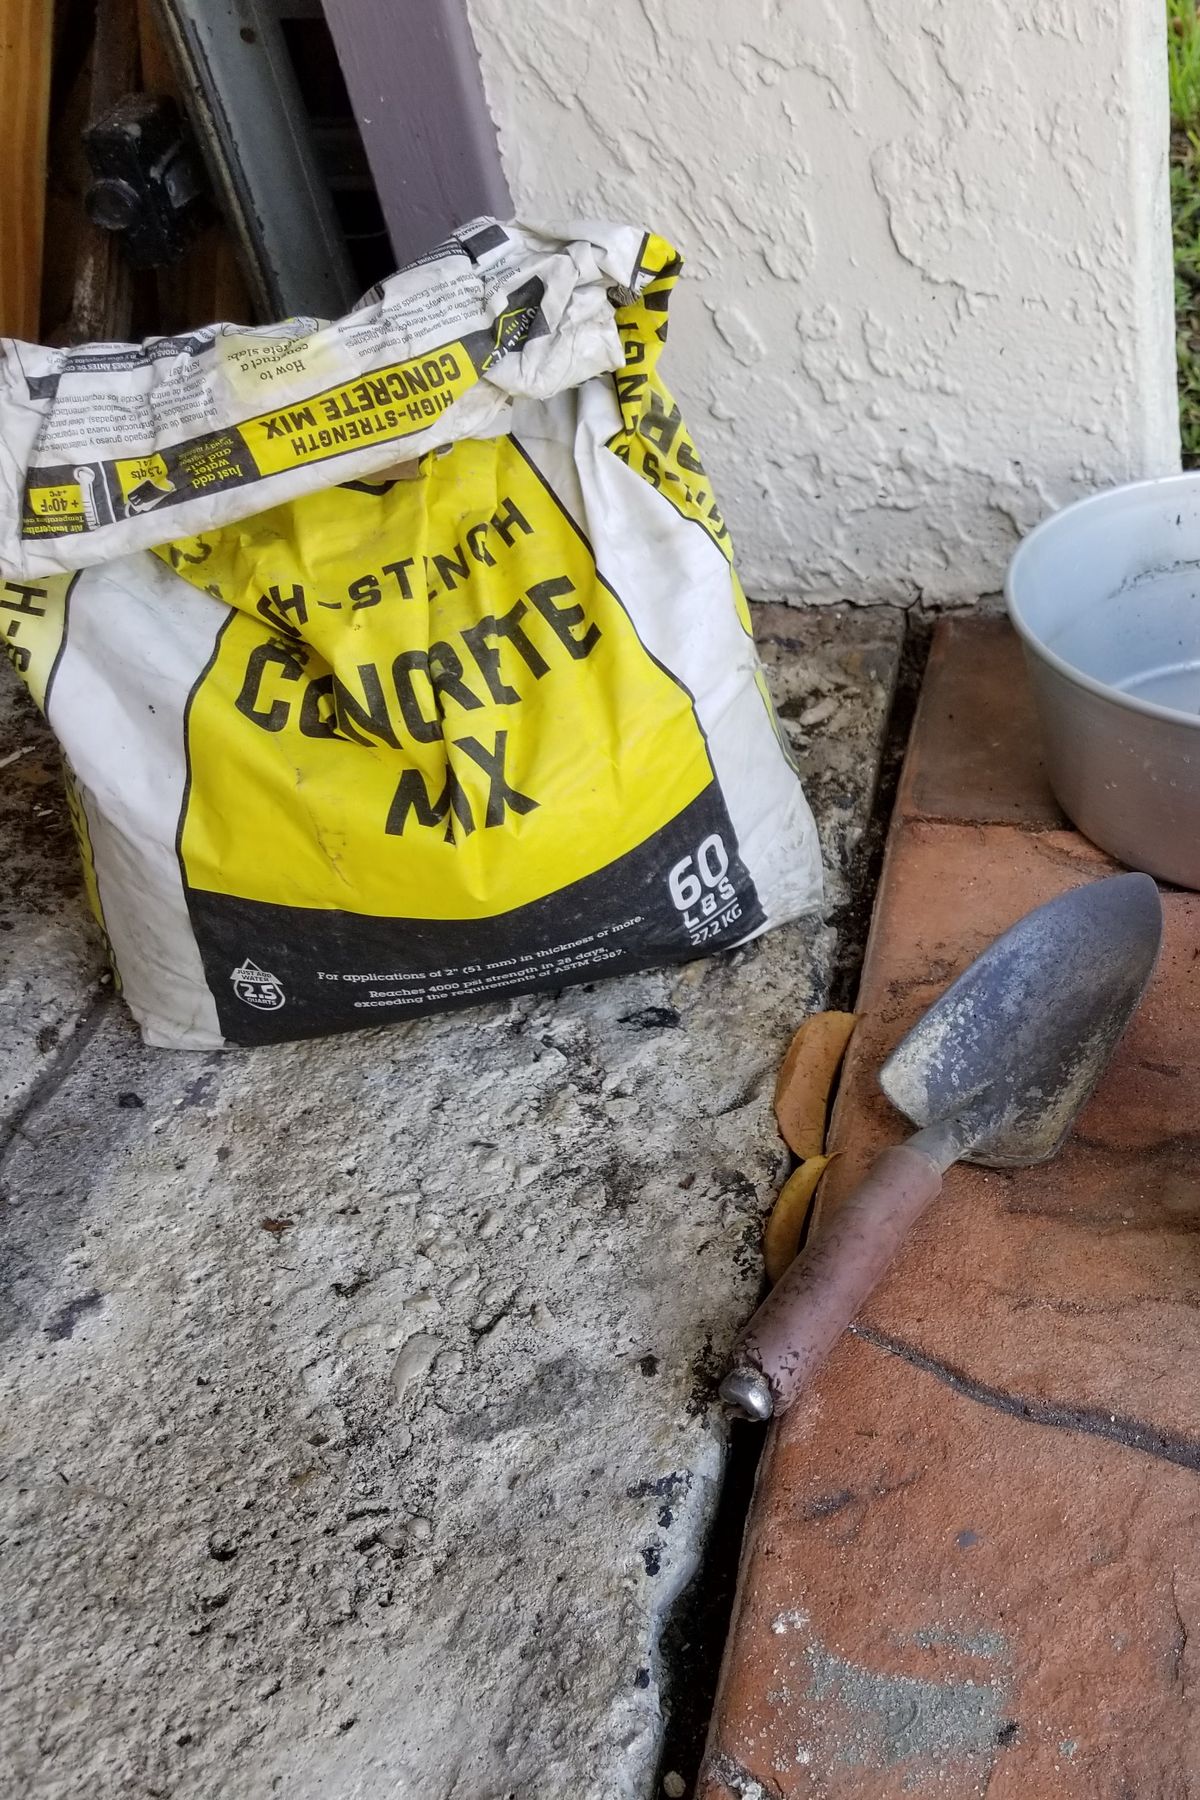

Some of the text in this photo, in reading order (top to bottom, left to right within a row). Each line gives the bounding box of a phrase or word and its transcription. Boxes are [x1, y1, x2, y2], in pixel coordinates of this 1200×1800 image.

[228, 348, 260, 361] slab:
[240, 363, 249, 372] a
[259, 360, 306, 381] How to
[319, 353, 462, 422] CONCRETE
[257, 406, 318, 440] MIX
[290, 389, 455, 457] HIGH-STRENGTH
[193, 458, 230, 476] water
[207, 448, 232, 462] and
[130, 468, 147, 480] qts
[191, 464, 244, 489] Just add
[668, 833, 729, 911] 60
[682, 876, 736, 929] LBS
[689, 903, 743, 946] 27.2 KG
[316, 970, 339, 981] For
[342, 970, 427, 983] applications
[429, 969, 444, 978] of
[462, 963, 483, 975] (51
[486, 957, 517, 971] mm)
[519, 952, 534, 963] in
[535, 934, 595, 959] thickness
[596, 929, 610, 939] or
[611, 914, 645, 933] more.
[241, 974, 270, 982] WATER
[353, 995, 424, 1008] exceeding
[426, 991, 449, 1001] the
[450, 974, 537, 998] requirements
[538, 968, 553, 978] of
[553, 959, 591, 973] ASTM
[368, 945, 609, 998] Reaches 4000 psi strength in 28 days,
[239, 982, 277, 1000] 2.5
[246, 997, 277, 1006] QUARTS
